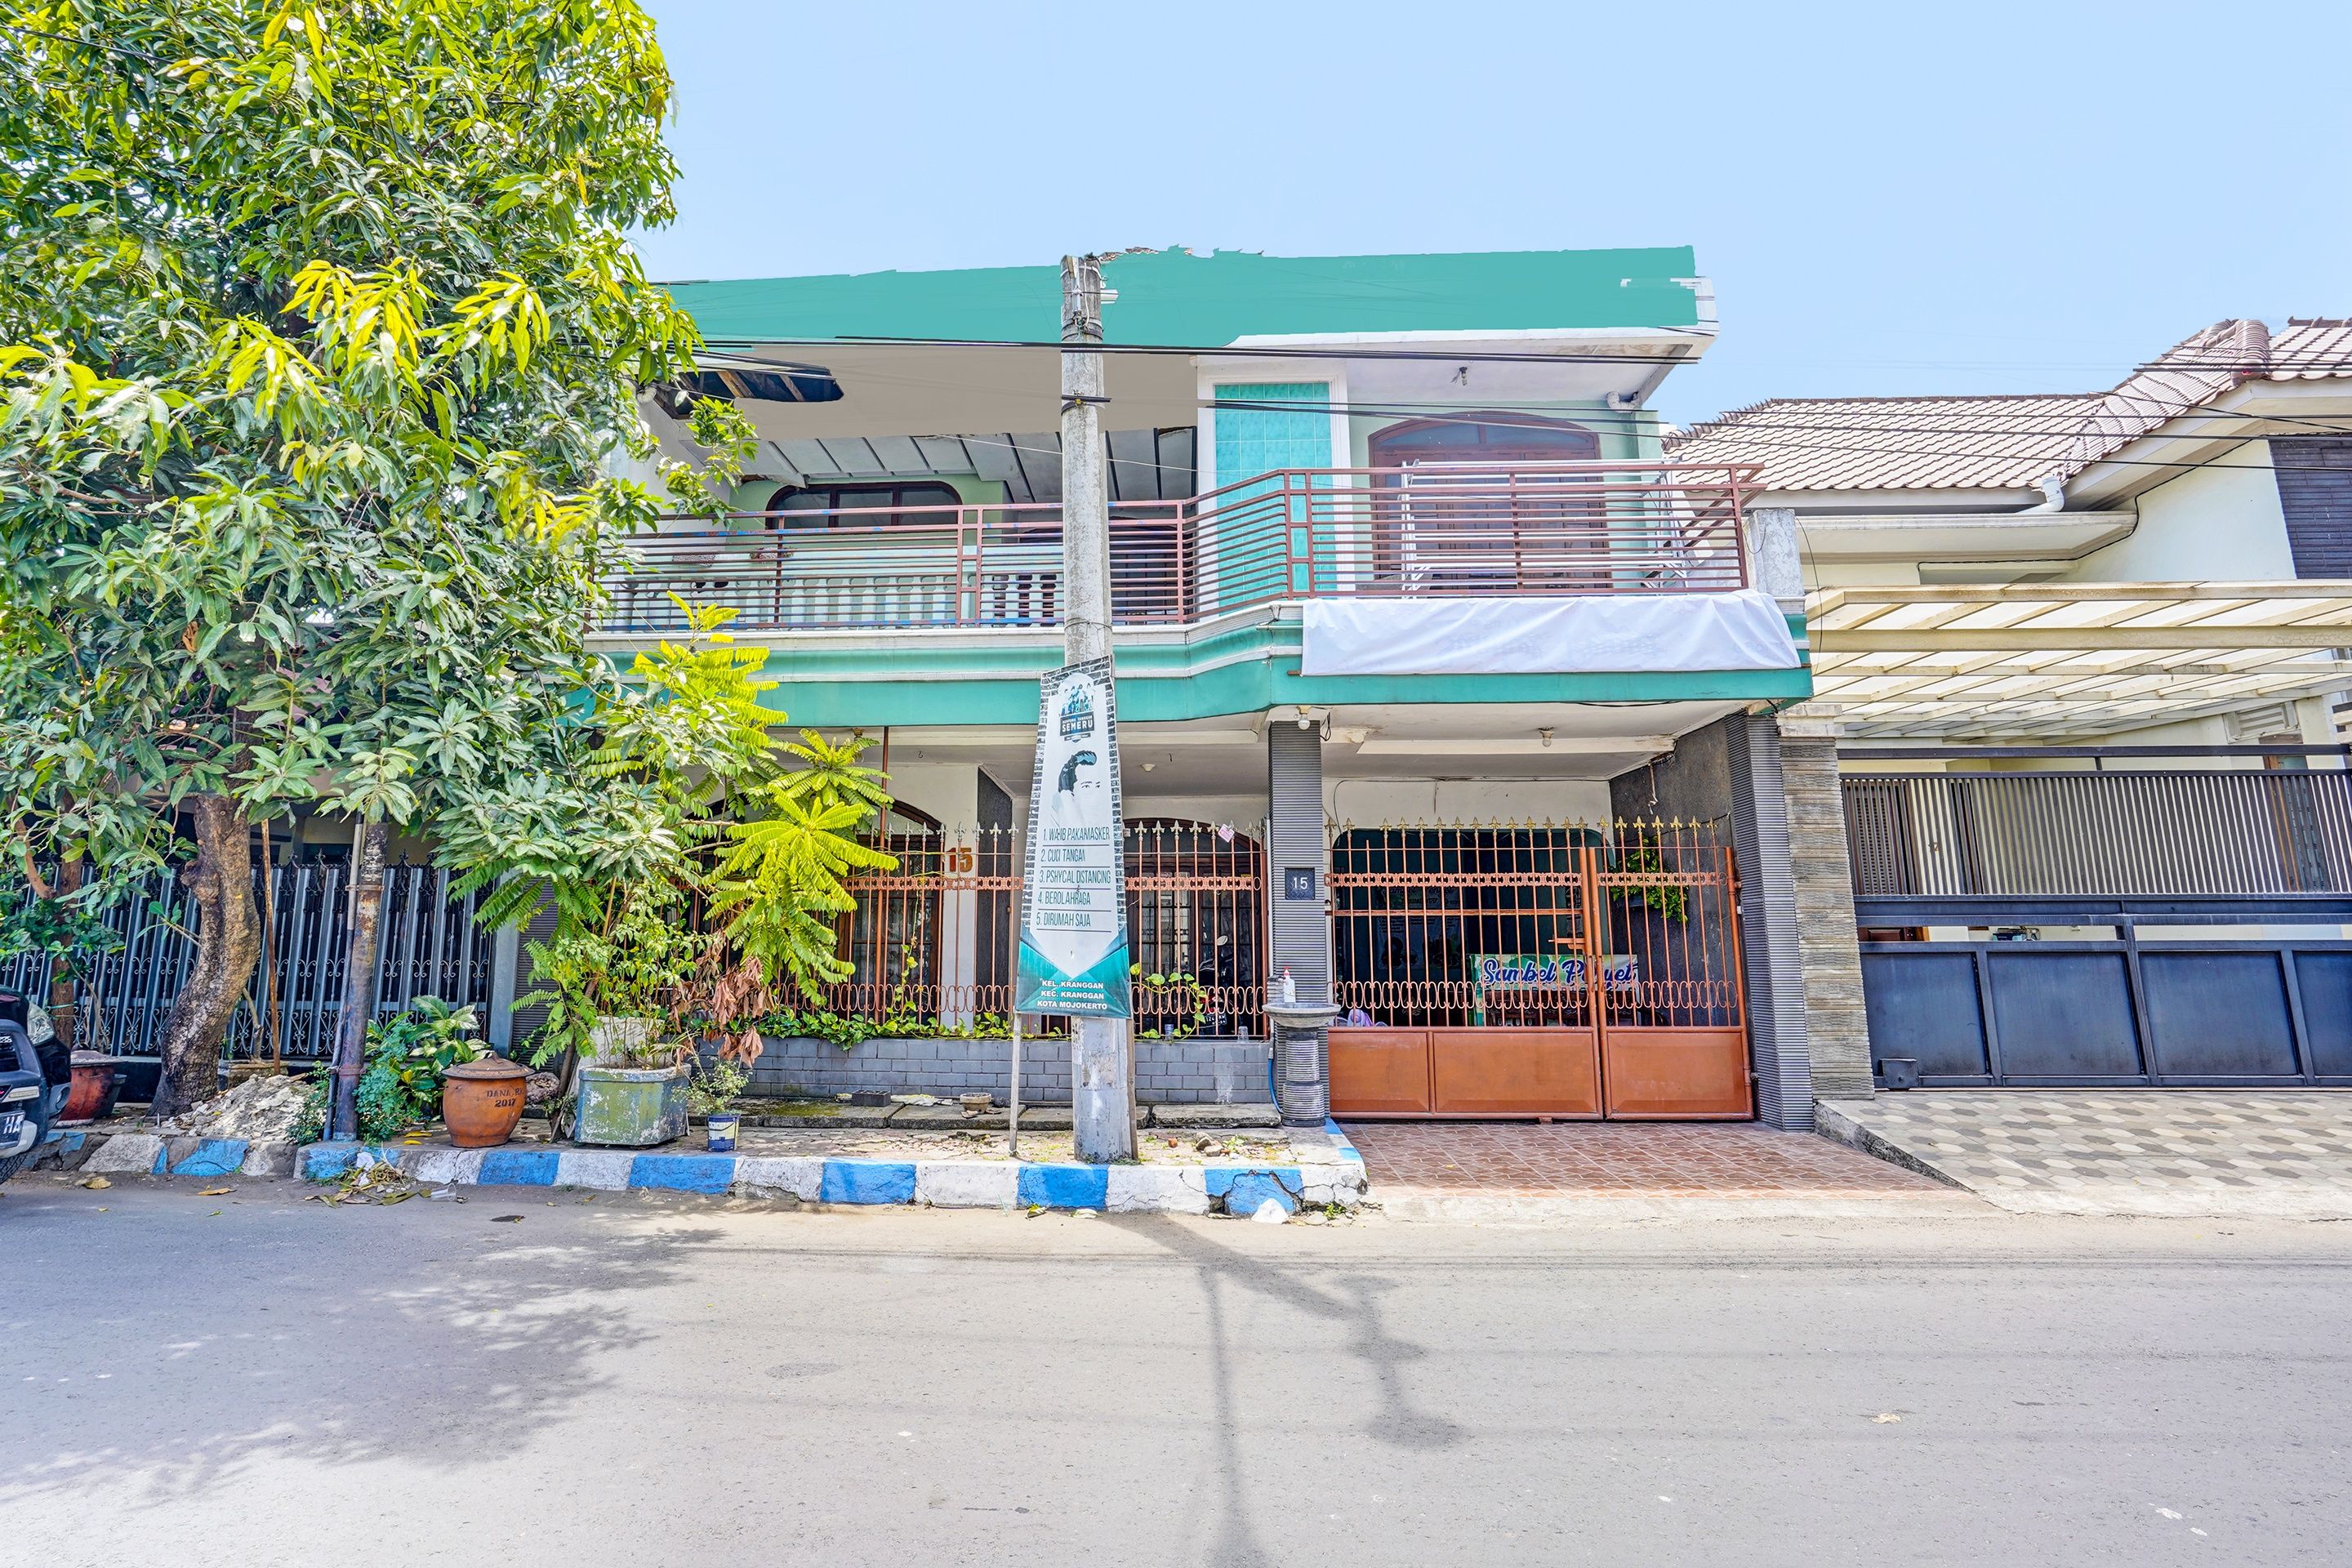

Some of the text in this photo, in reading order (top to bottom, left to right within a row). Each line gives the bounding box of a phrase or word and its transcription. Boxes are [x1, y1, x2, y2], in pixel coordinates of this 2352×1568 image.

[1062, 719, 1093, 733] SEMERU
[1043, 828, 1048, 841] 1.
[947, 848, 973, 872] 15
[1040, 849, 1046, 862] 2.
[1039, 870, 1045, 883] 3.
[1293, 876, 1308, 890] 15
[1037, 891, 1091, 906] 4. BEROLAHRAGA
[1036, 912, 1041, 925] 5.
[1481, 959, 1637, 990] Sambel Pyet
[1061, 981, 1104, 989] KRANGGAN
[1061, 991, 1104, 1000] KRANGGAN
[1037, 1000, 1107, 1010] KOTA MOJOKERTO
[495, 1098, 517, 1107] 2017
